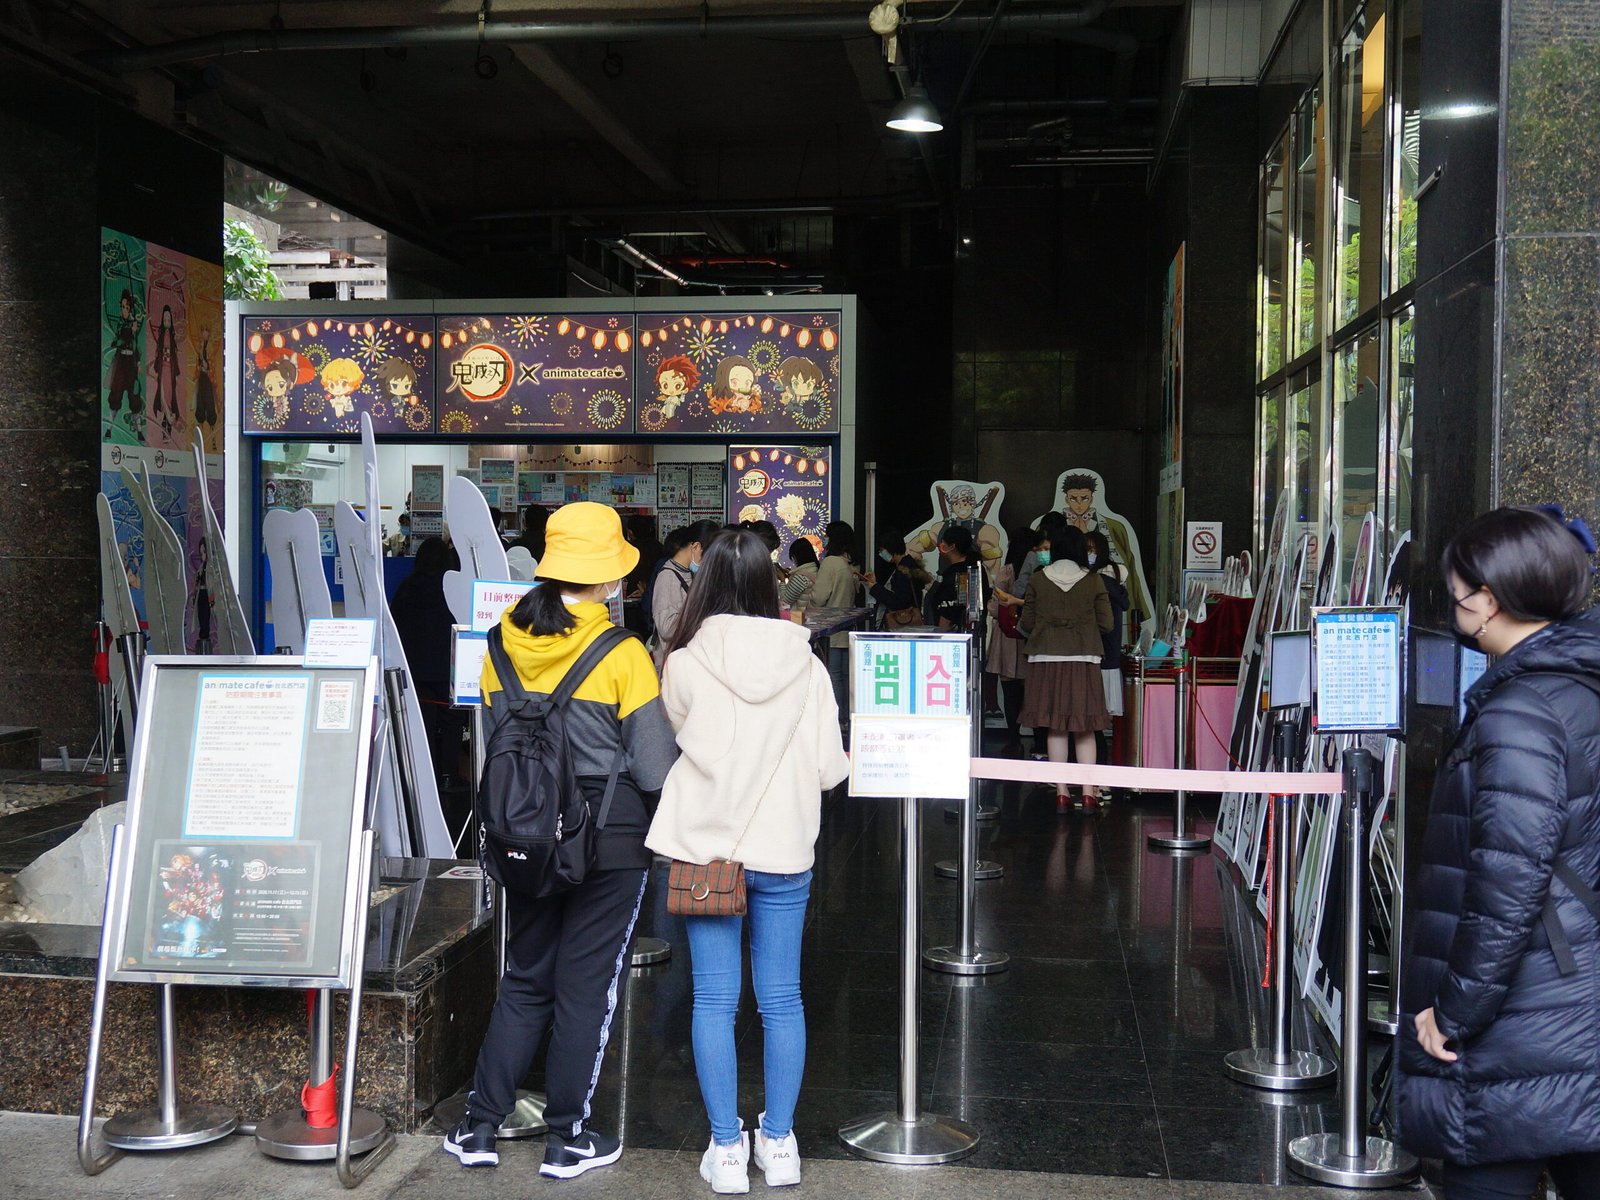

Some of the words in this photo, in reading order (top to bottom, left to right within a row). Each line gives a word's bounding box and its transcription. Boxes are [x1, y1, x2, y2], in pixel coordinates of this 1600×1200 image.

[874, 653, 900, 706] 出口
[926, 655, 952, 707] 入口
[507, 850, 527, 860] FILA
